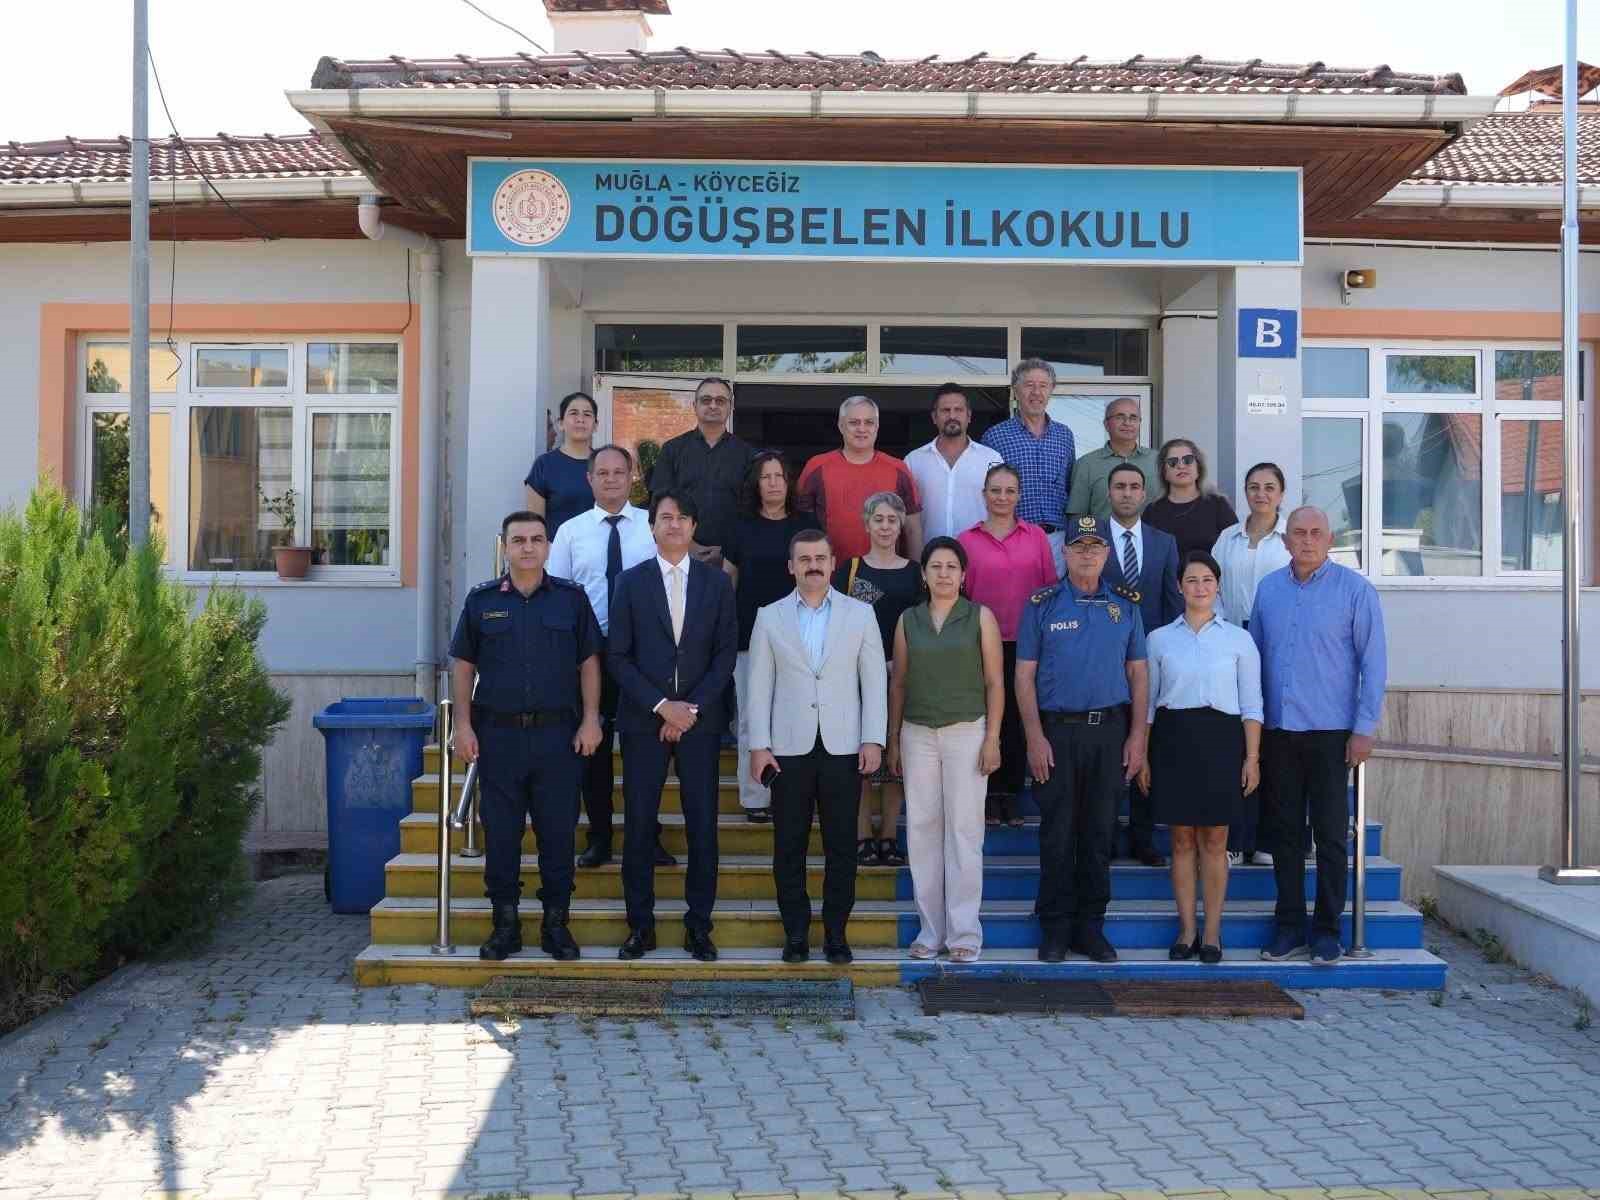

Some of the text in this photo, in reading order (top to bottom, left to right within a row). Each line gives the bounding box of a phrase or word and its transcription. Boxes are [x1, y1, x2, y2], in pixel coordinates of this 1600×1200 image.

[595, 170, 672, 191] MUĞLA
[694, 171, 800, 193] KÖYCEĞİZ
[595, 195, 926, 248] DÖĞÜŞBELEN
[945, 200, 1190, 248] İLKOKULU
[1255, 318, 1282, 347] B
